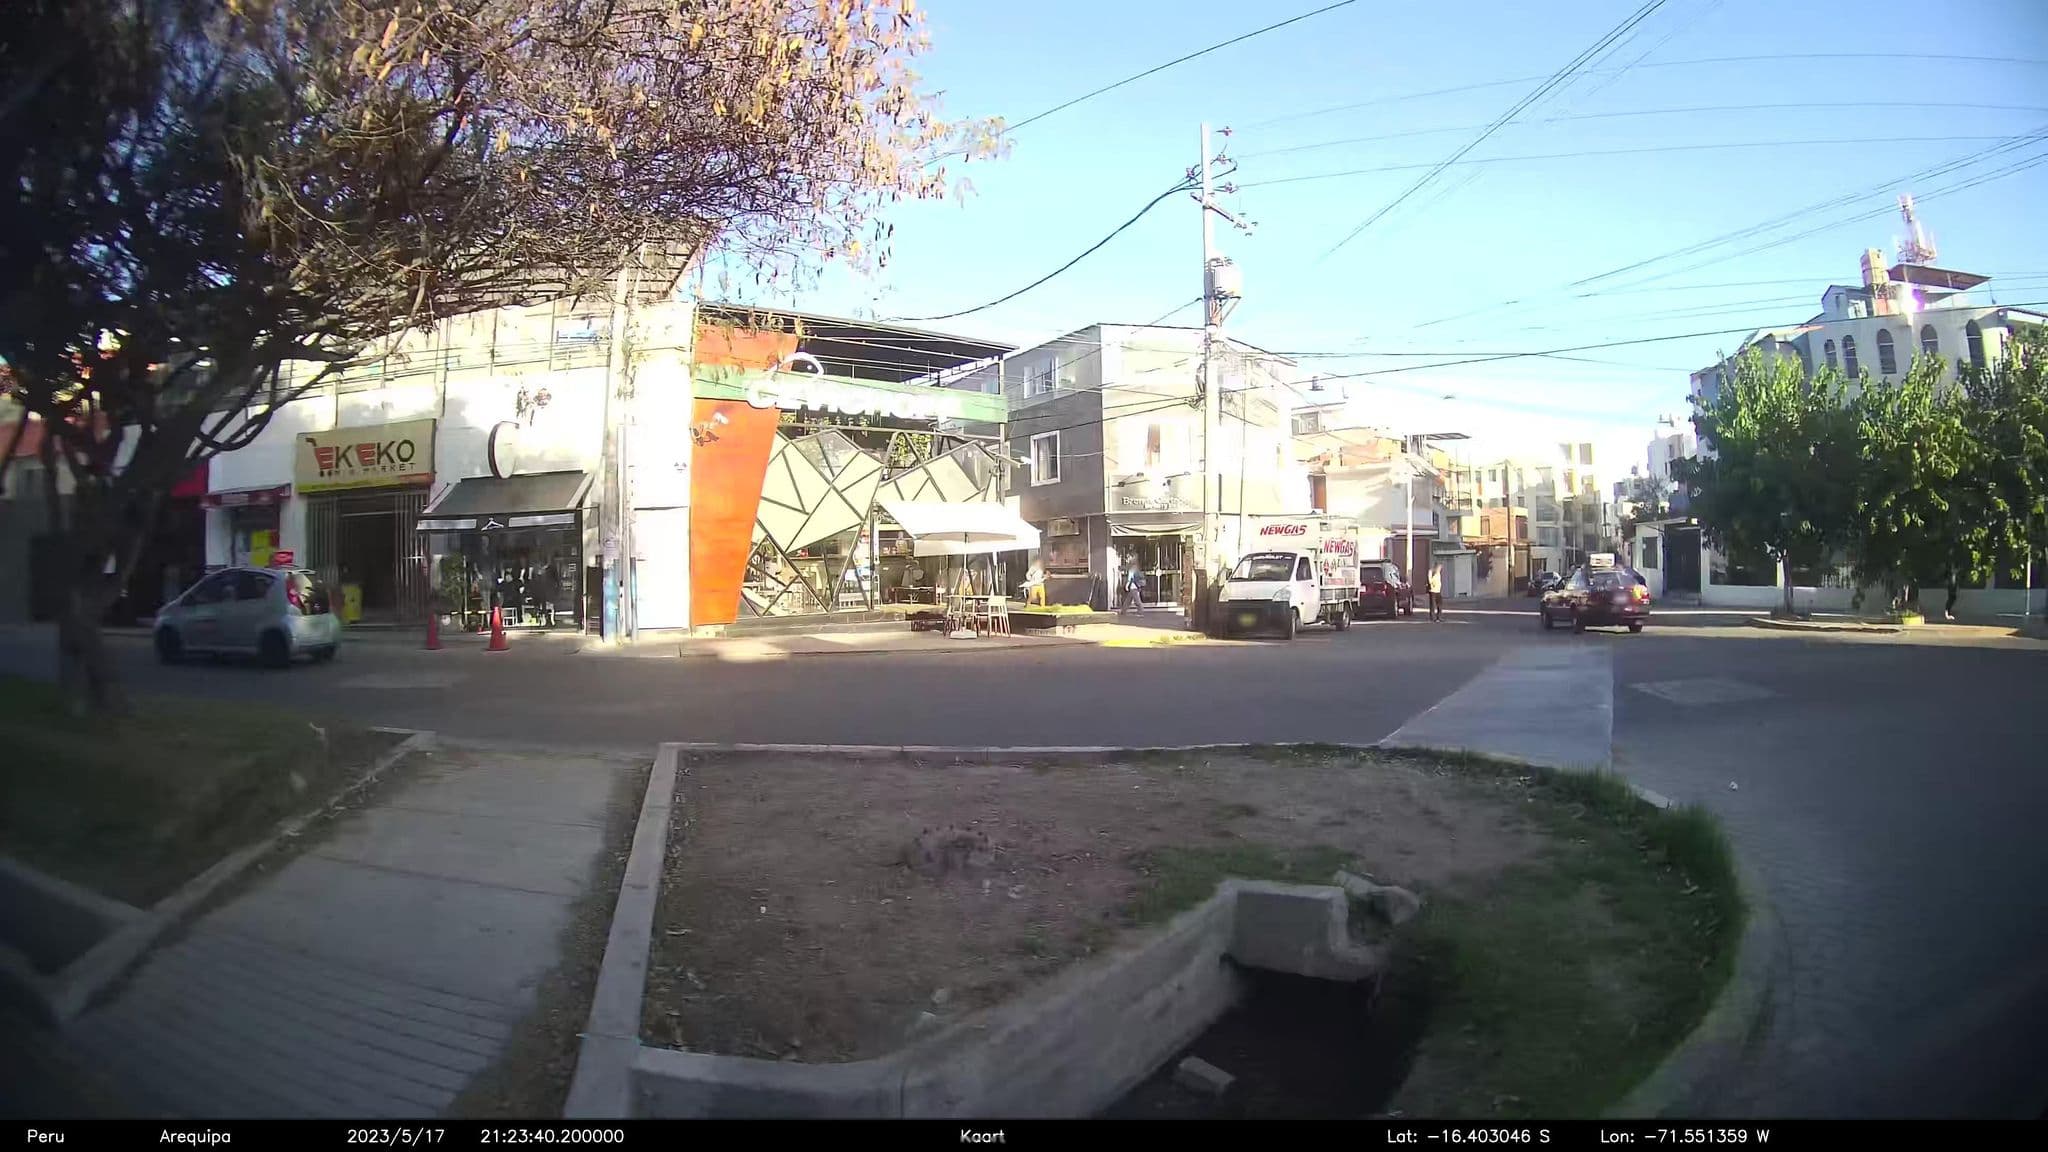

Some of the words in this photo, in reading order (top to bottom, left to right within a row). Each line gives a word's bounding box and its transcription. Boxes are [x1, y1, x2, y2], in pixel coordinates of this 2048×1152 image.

[312, 439, 416, 470] EKEKO
[1260, 524, 1308, 536] NEWGAS
[1323, 539, 1355, 557] NEWGAS
